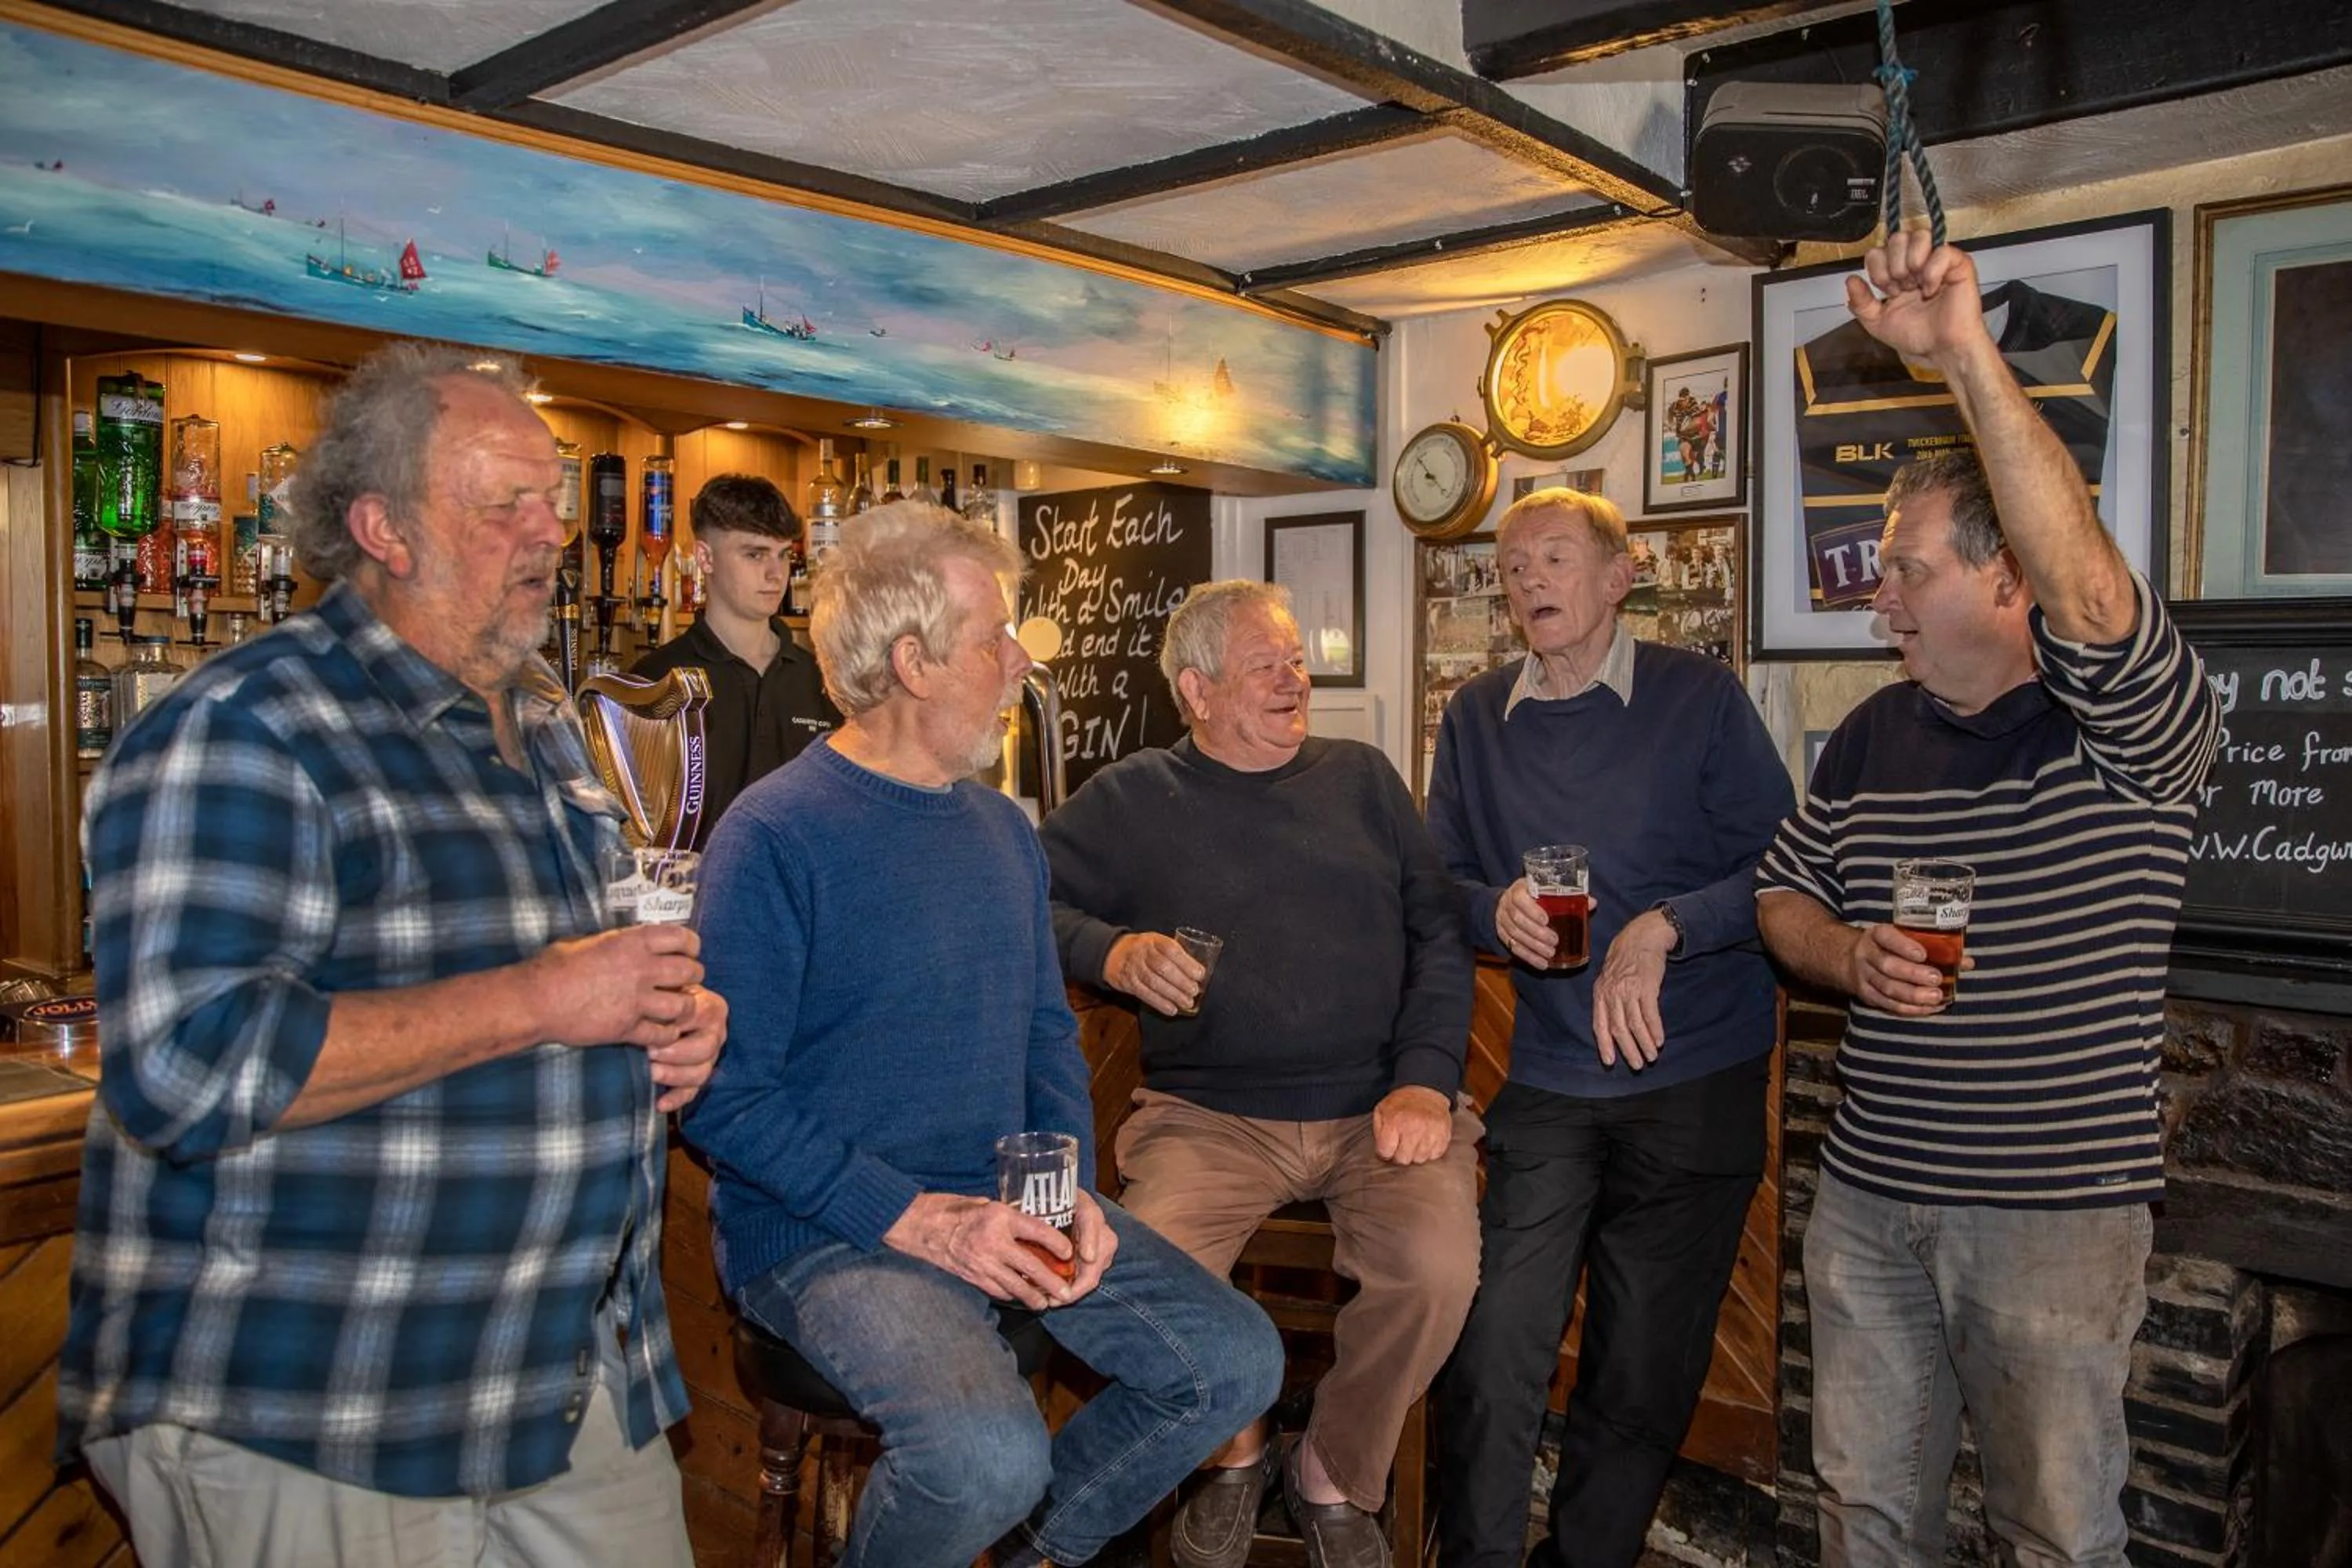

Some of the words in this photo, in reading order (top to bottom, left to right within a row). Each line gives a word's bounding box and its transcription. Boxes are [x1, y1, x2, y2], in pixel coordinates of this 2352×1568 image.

[1835, 442, 1895, 463] BLK
[1030, 498, 1099, 561] Start
[1106, 493, 1184, 549] Each
[1058, 557, 1107, 612] Day
[1081, 627, 1121, 659] end
[1127, 623, 1152, 657] it
[1056, 664, 1100, 700] With
[1112, 670, 1129, 699] a
[2260, 659, 2326, 701] not
[1061, 704, 1131, 761] GIN
[685, 736, 702, 815] GUINNESS
